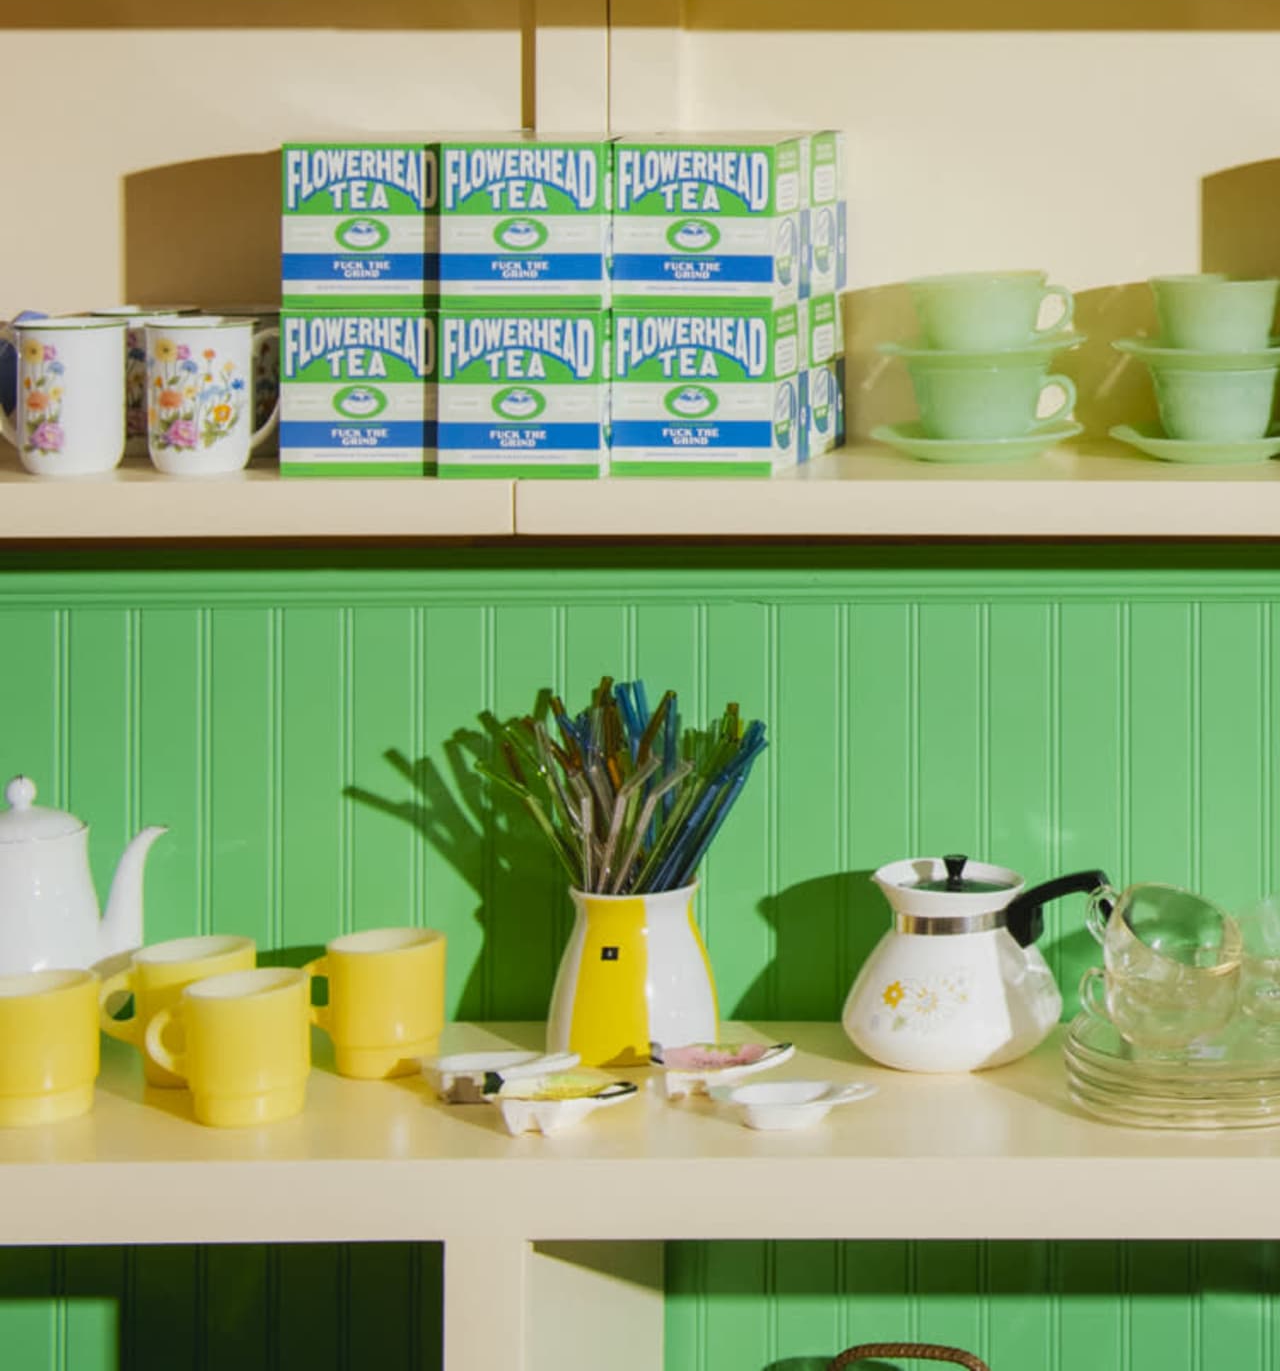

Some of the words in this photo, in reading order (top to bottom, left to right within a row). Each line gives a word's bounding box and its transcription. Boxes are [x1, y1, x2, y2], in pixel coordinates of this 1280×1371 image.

[286, 148, 437, 210] FLOWERHEAD
[445, 148, 596, 210] FLOWERHEAD
[617, 149, 768, 211] FLOWERHEAD
[331, 181, 389, 210] TEA
[490, 181, 548, 210] TEA
[662, 182, 720, 211] TEA
[333, 260, 363, 271] FUCK
[368, 260, 390, 271] THE
[344, 269, 379, 279] GRIND
[491, 260, 521, 271] FUCK
[526, 260, 548, 271] THE
[502, 269, 537, 279] GRIND
[663, 261, 693, 272] FUCK
[698, 261, 720, 272] THE
[674, 270, 709, 280] GRIND
[284, 316, 435, 378] FLOWERHEAD
[443, 317, 594, 379] FLOWERHEAD
[615, 315, 766, 377] FLOWERHEAD
[329, 349, 387, 378] TEA
[488, 350, 546, 379] TEA
[660, 348, 718, 377] TEA
[331, 428, 361, 439] FUCK
[366, 428, 388, 439] THE
[342, 437, 377, 447] GRIND
[489, 429, 519, 440] FUCK
[524, 429, 546, 440] THE
[662, 427, 692, 438] FUCK
[697, 427, 719, 438] THE
[673, 436, 708, 446] GRIND
[500, 438, 535, 448] GRIND
